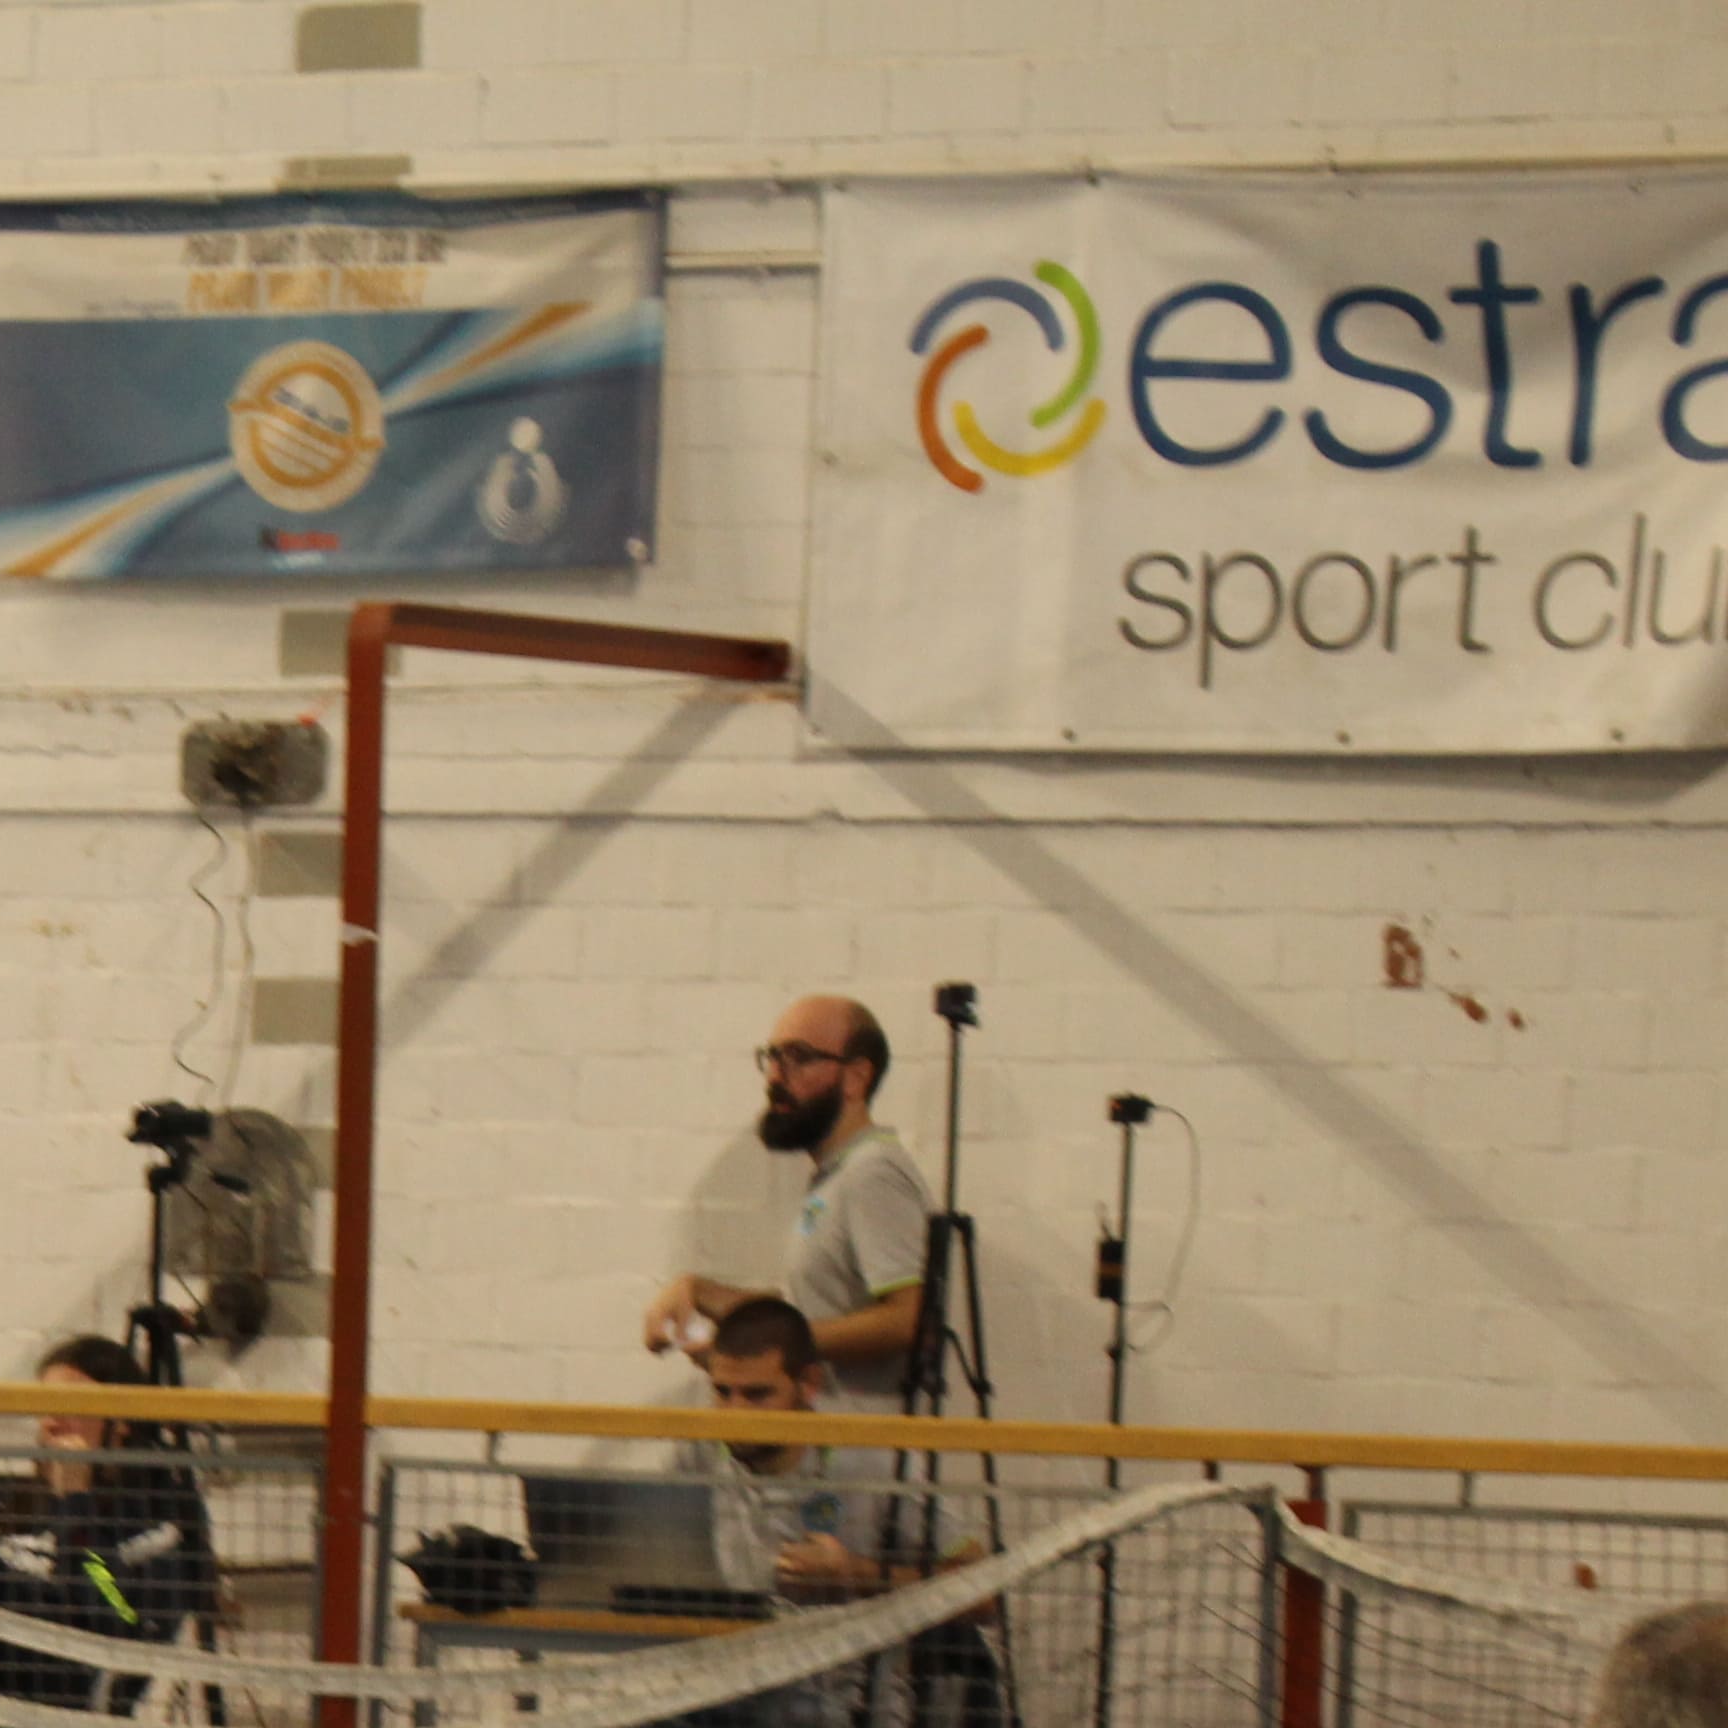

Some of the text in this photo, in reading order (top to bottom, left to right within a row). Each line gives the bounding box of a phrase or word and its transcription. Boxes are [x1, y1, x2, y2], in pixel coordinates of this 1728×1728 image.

[1126, 238, 1728, 470] estra
[1117, 511, 1728, 692] sport clu
